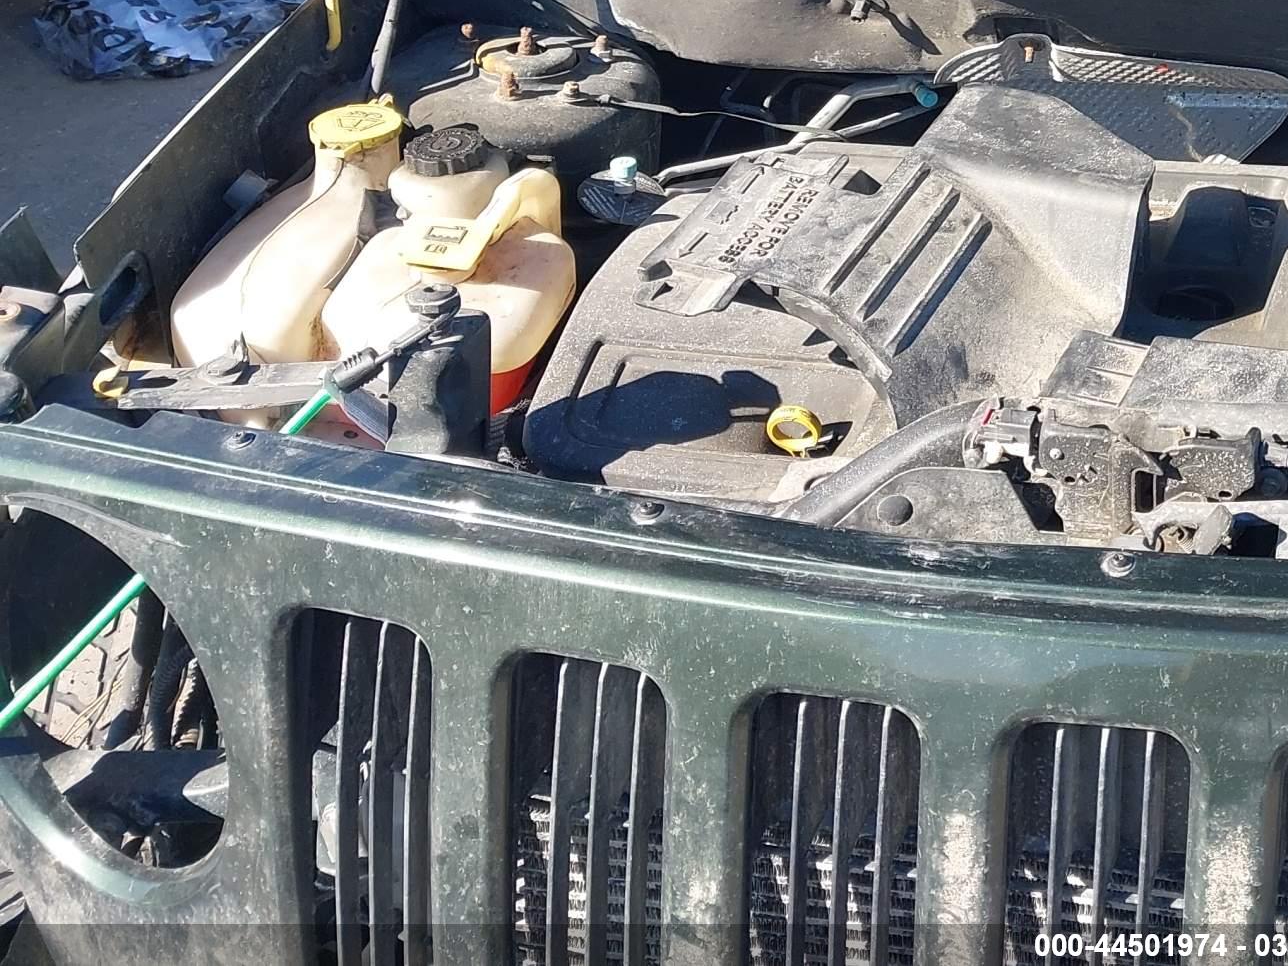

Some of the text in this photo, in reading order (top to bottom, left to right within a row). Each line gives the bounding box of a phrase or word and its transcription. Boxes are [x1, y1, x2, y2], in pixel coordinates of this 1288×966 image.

[718, 175, 804, 263] BATTERY ACCESS
[749, 188, 819, 257] REMOVE FOR
